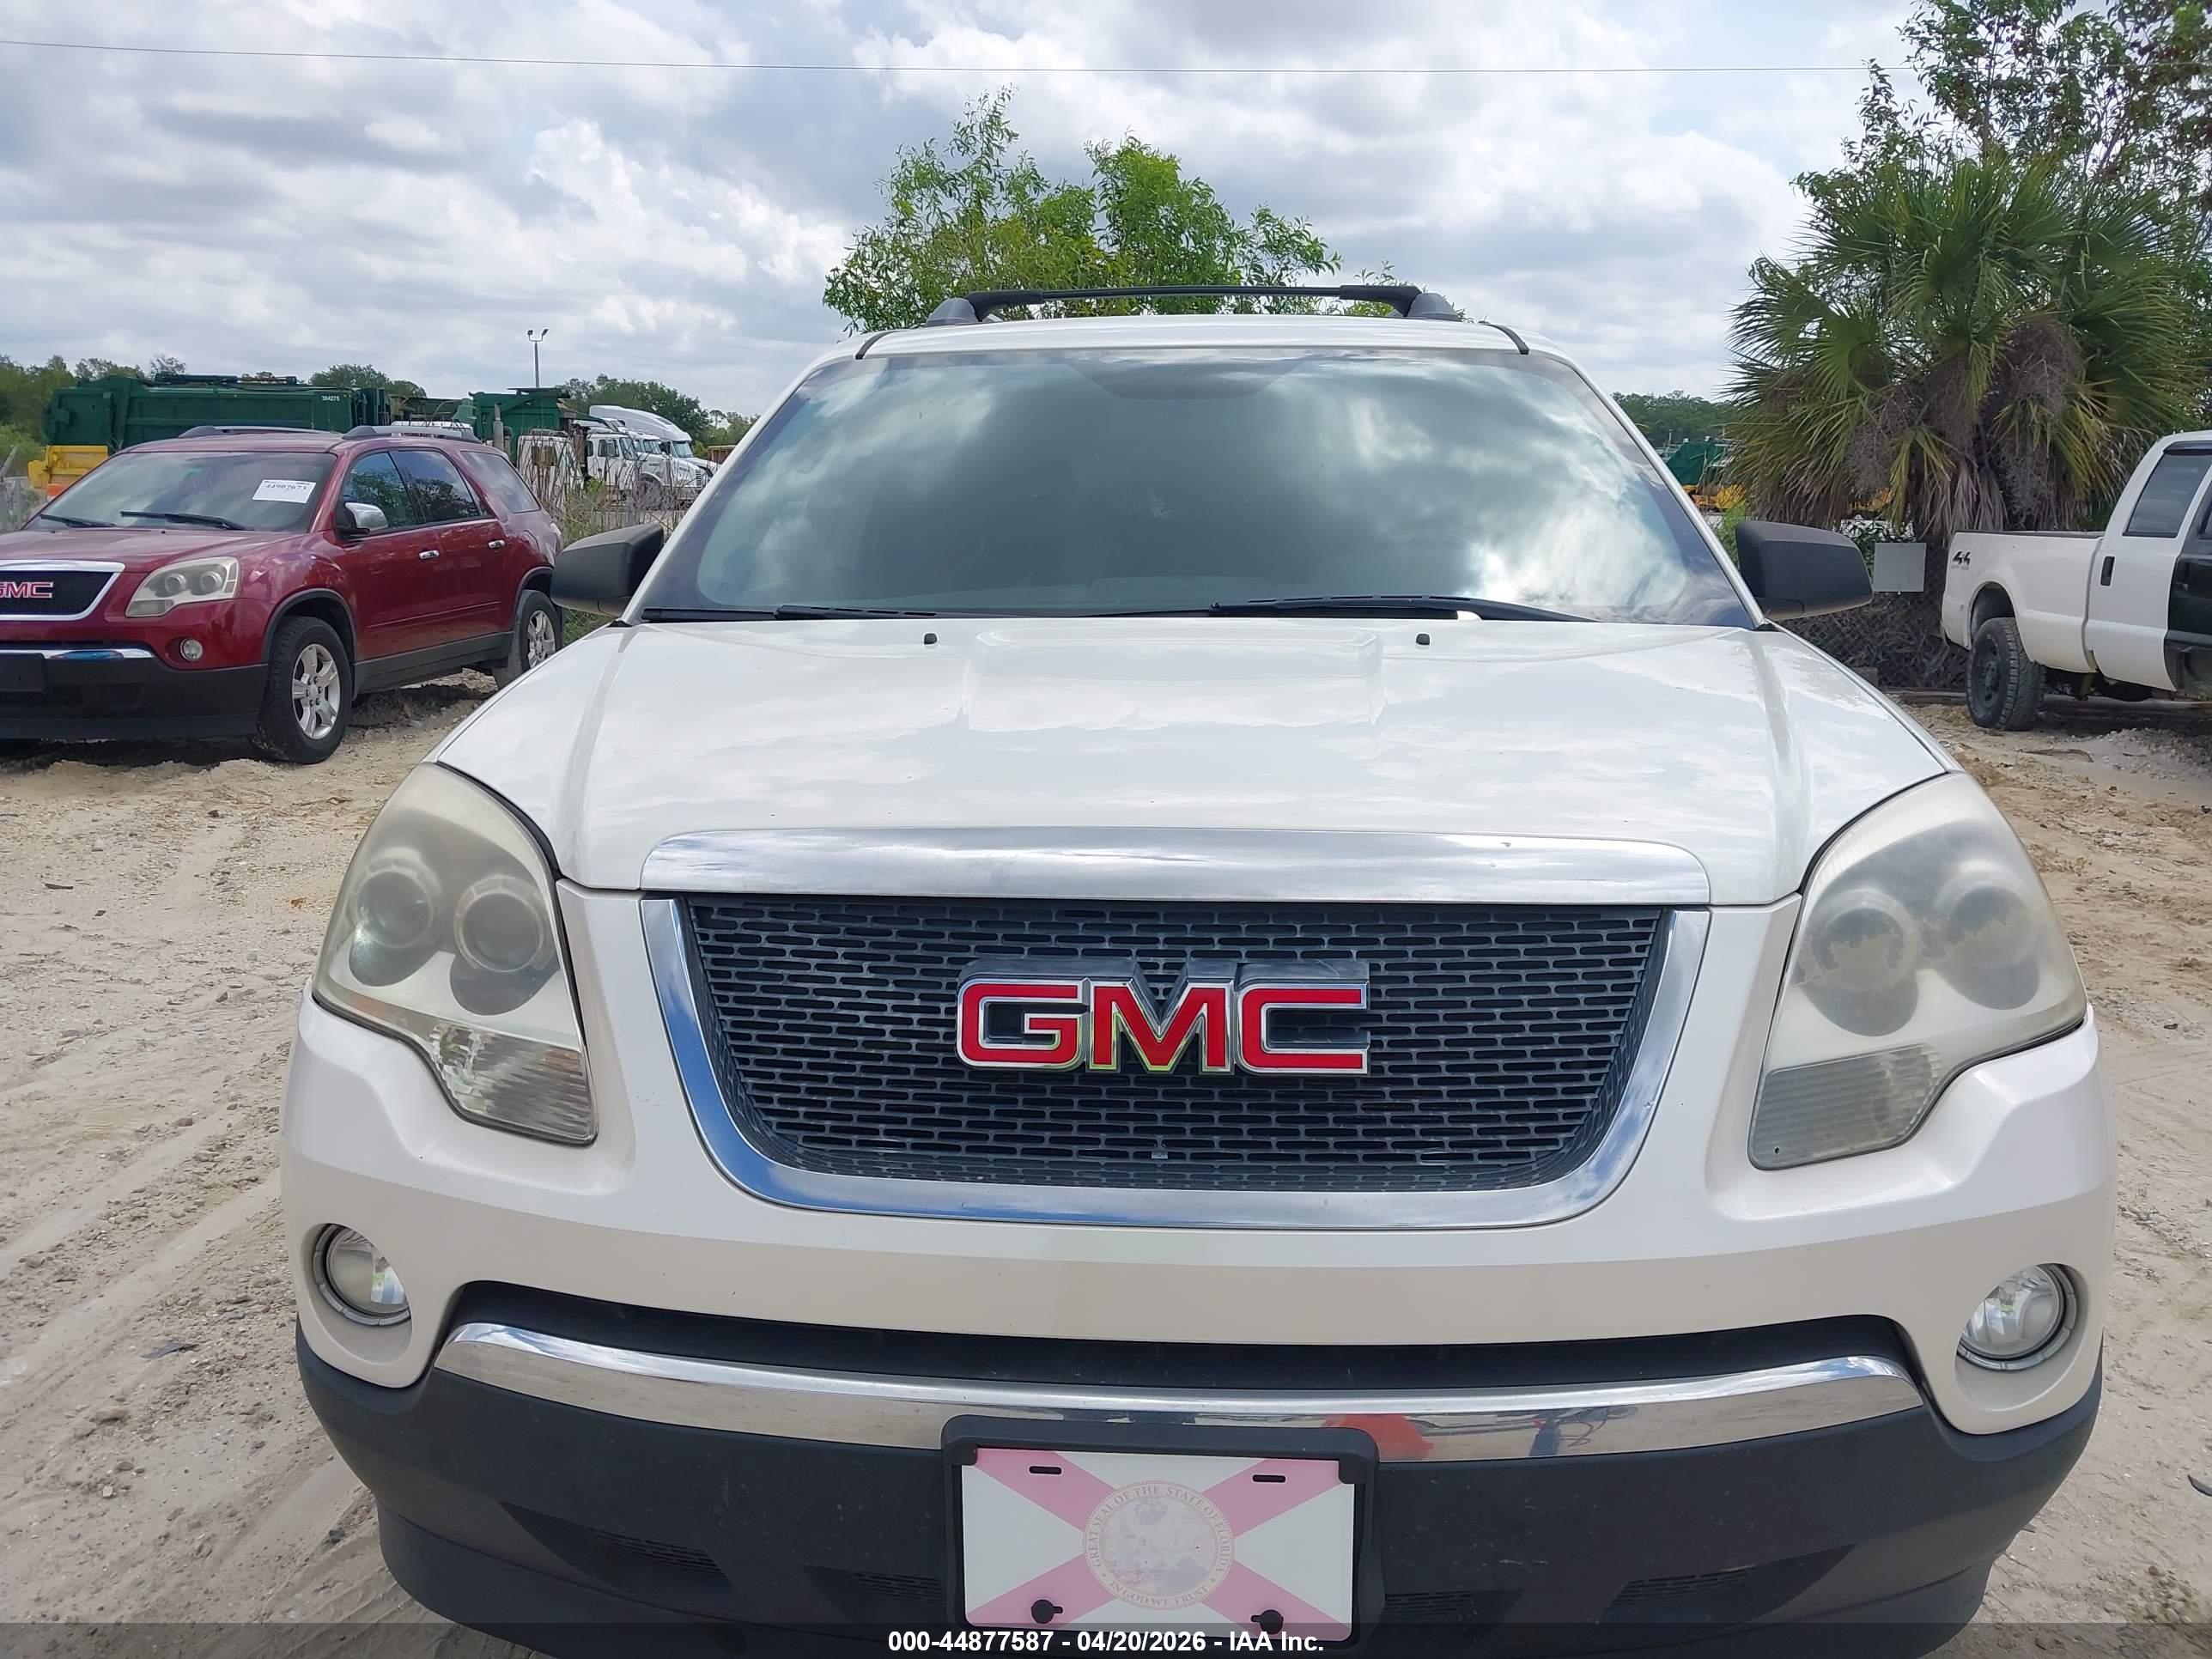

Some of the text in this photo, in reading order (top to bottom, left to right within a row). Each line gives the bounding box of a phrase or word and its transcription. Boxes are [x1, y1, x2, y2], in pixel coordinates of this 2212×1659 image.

[0, 581, 54, 599] MC
[956, 977, 1370, 1075] GMC
[1088, 1485, 1231, 1572] GREAT SEAL OF THE STATE OF FLORIDA
[1109, 1580, 1209, 1607] IN GOD WE TRUST
